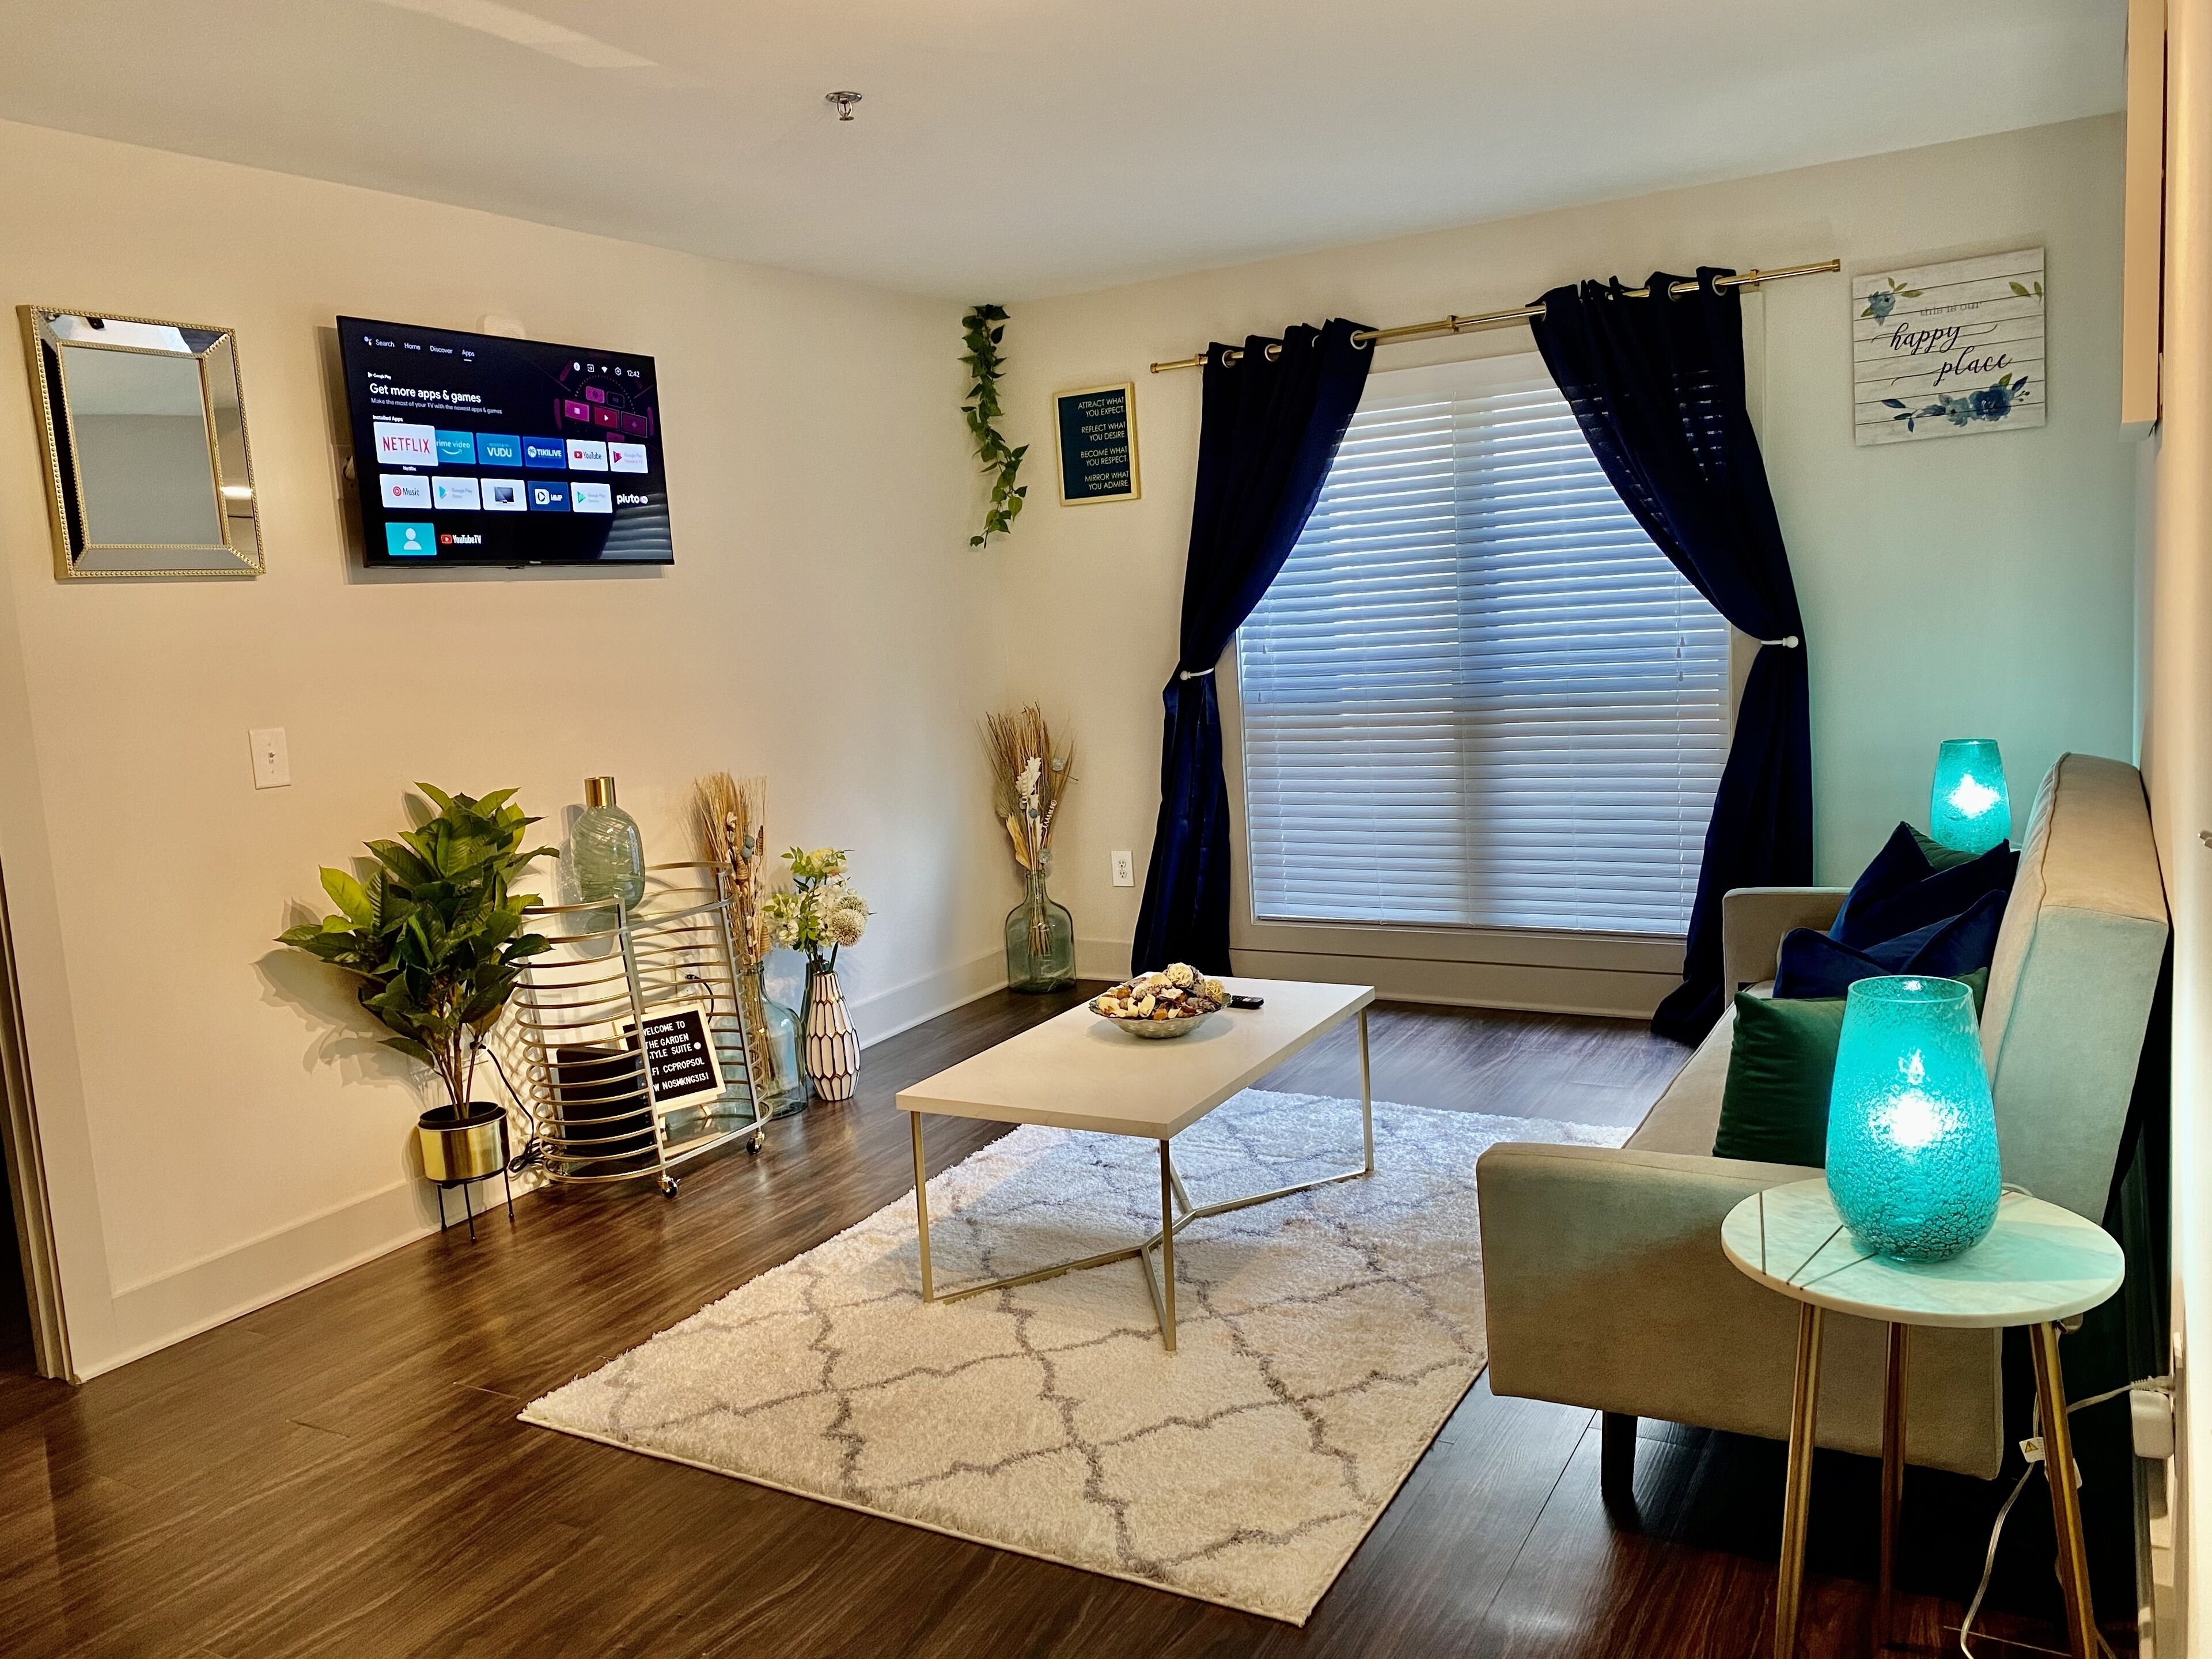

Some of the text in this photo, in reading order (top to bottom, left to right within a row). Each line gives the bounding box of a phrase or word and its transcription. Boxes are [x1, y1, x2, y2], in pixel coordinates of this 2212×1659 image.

[376, 339, 475, 357] Search Home Discover Apps
[627, 370, 640, 378] 12:42
[369, 383, 482, 404] Get more apps & games
[1078, 396, 1124, 410] ATTRACT WHAT
[1085, 409, 1099, 417] YOU
[1081, 421, 1126, 433] REFLECT WHAT
[436, 439, 471, 448] rime video
[1089, 434, 1103, 442] YOU
[382, 436, 431, 454] NETFLIX
[487, 446, 512, 458] VUDU
[536, 448, 562, 457] TIKILIVE
[583, 451, 602, 460] YouTube
[1081, 446, 1127, 459] BECOME WHAT
[1086, 458, 1099, 467] YOU
[1085, 471, 1129, 482] MIRROR WHAT
[403, 487, 420, 497] Music
[1089, 483, 1101, 491] YOU
[616, 494, 640, 505] pluto
[675, 1020, 685, 1029] TO
[645, 1032, 690, 1050] THE GARDEN
[649, 1043, 692, 1060] TYLE SUITE
[651, 1056, 705, 1076] FI CCPROPSOL
[662, 1072, 709, 1090] NOSMKNG3131
